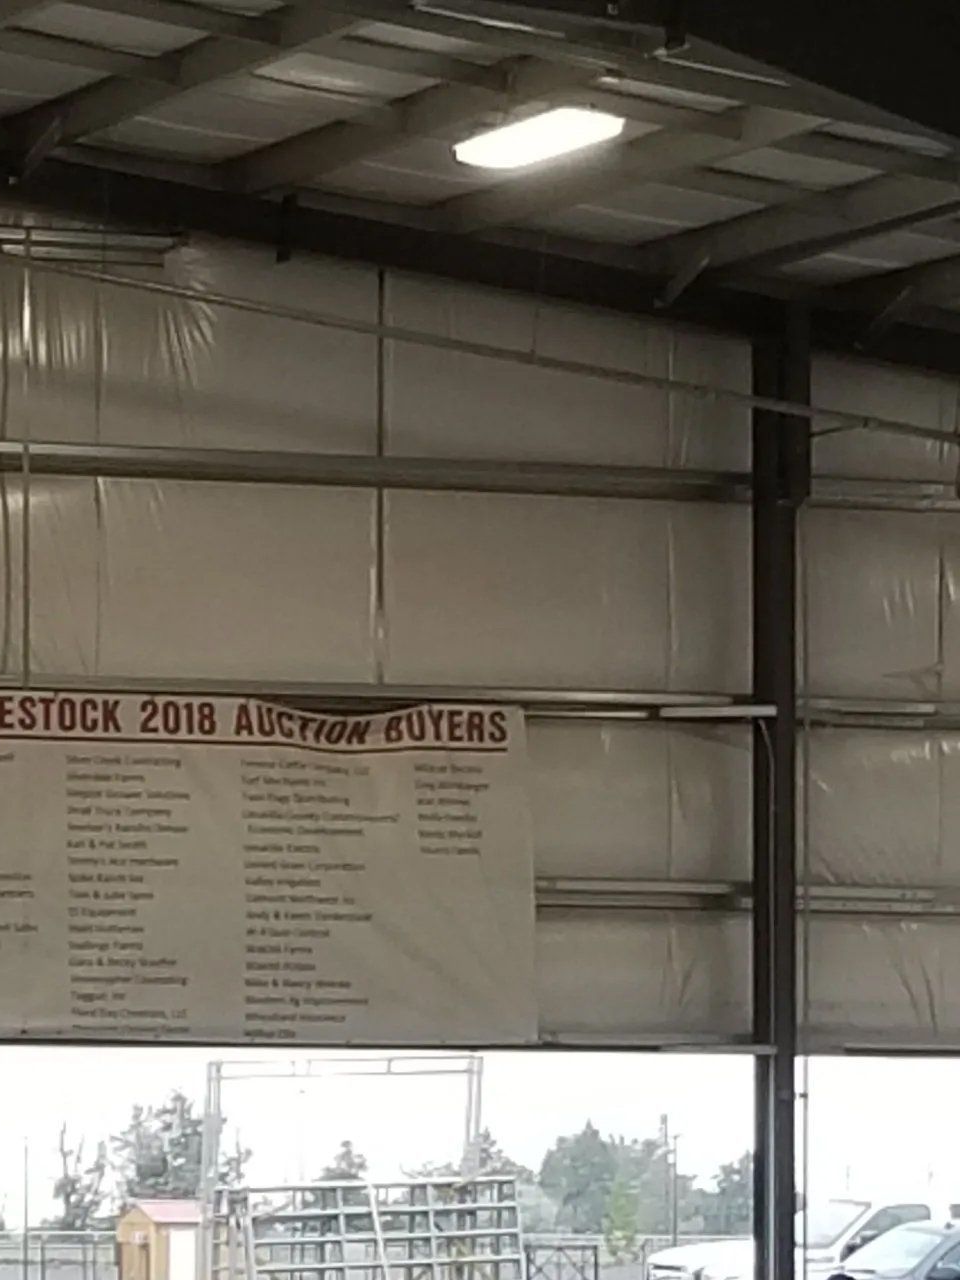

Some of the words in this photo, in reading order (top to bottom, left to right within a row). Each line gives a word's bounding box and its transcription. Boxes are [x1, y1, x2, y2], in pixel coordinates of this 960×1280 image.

[141, 701, 215, 735] 2018
[235, 705, 370, 745] AUCTION
[385, 707, 508, 743] BUYERS
